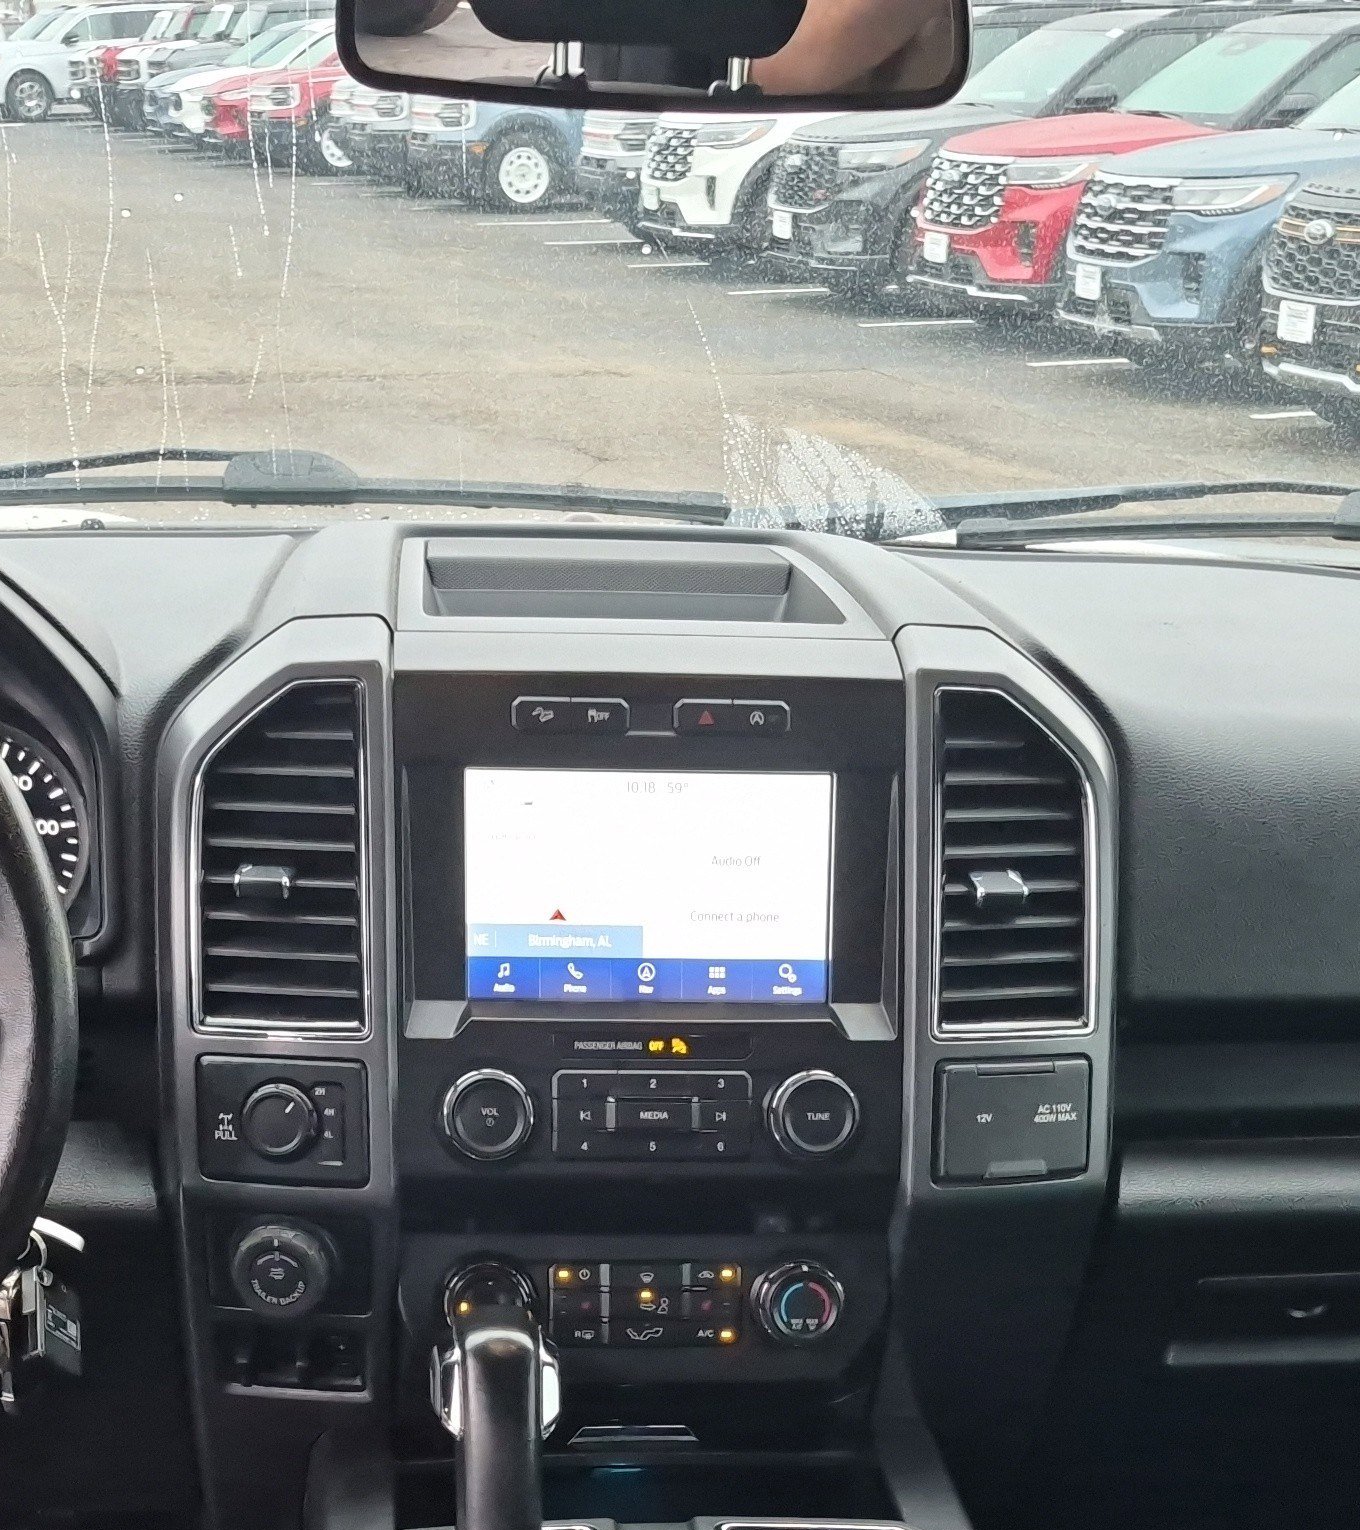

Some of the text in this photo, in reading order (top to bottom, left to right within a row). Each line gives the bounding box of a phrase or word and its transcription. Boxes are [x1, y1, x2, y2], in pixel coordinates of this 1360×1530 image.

[712, 855, 761, 867] Audio Off
[690, 910, 734, 923] Connect
[745, 911, 780, 925] phone
[473, 933, 489, 946] NE
[528, 933, 595, 949] Birmingham,
[574, 1040, 665, 1051] PASSENGER AIRBAG OFF
[649, 1078, 658, 1088] 2
[717, 1078, 725, 1088] 3
[481, 1107, 500, 1117] VOL
[1037, 1103, 1072, 1114] AC 110V
[639, 1110, 669, 1120] MEDIA
[806, 1111, 831, 1121] TUNE
[976, 1113, 993, 1123] 12V
[1057, 1112, 1077, 1122] MAX
[214, 1130, 238, 1140] PULL
[580, 1141, 589, 1151] 4
[649, 1141, 657, 1151] 5
[717, 1141, 725, 1151] 6
[251, 1278, 278, 1304] TRAILER
[696, 1329, 715, 1338] A/C
